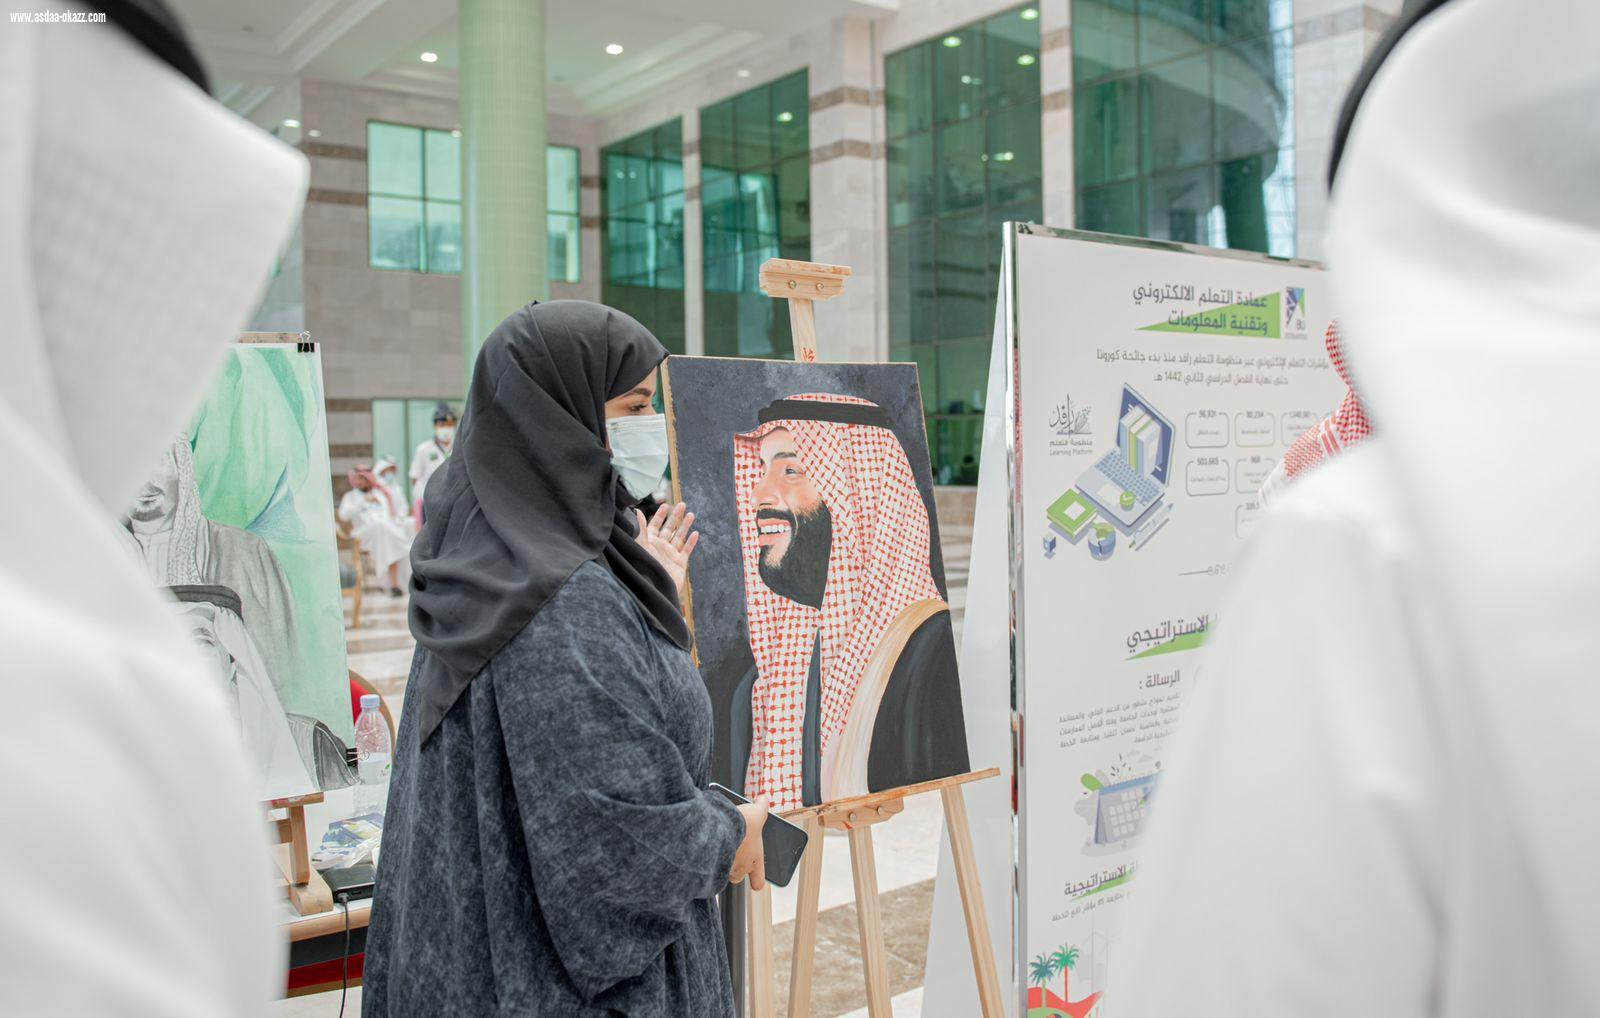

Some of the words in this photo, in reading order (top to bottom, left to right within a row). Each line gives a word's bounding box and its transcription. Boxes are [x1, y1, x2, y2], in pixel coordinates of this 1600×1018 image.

[1132, 281, 1195, 306] الالكتروني
[1198, 287, 1234, 307] التعلم
[1237, 290, 1269, 308] عمادة
[1167, 309, 1227, 332] المعلومات
[1230, 313, 1269, 336] وتقنية
[1096, 347, 1120, 363] كورونا
[1122, 349, 1146, 364] جائحة
[1162, 351, 1177, 363] منذ
[1164, 371, 1182, 382] 1442
[1126, 613, 1209, 654] الاستراتيجي
[1145, 668, 1181, 690] الرسالة
[1063, 864, 1127, 898] الاستراتيجية
